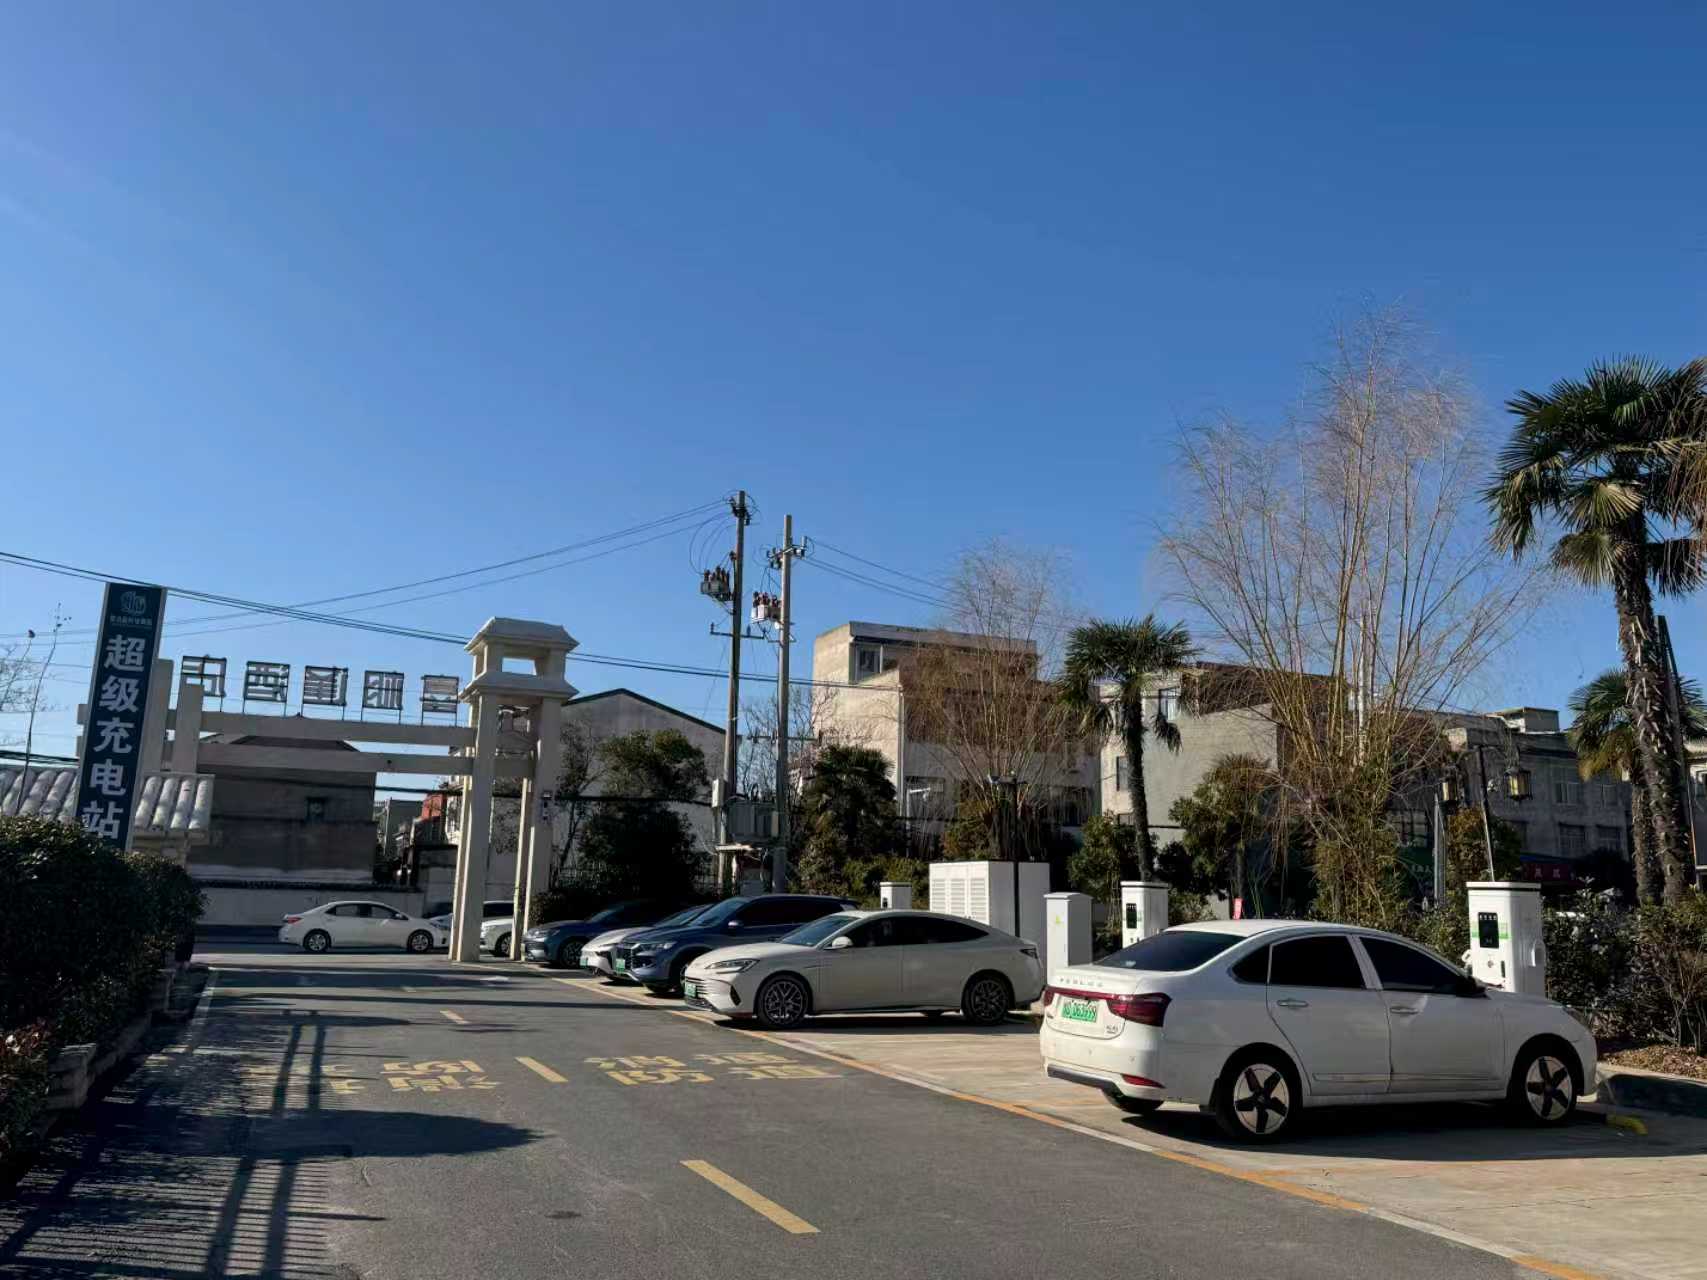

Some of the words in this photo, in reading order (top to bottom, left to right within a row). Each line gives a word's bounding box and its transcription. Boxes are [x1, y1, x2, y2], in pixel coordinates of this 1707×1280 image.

[81, 634, 146, 840] 超级充电站
